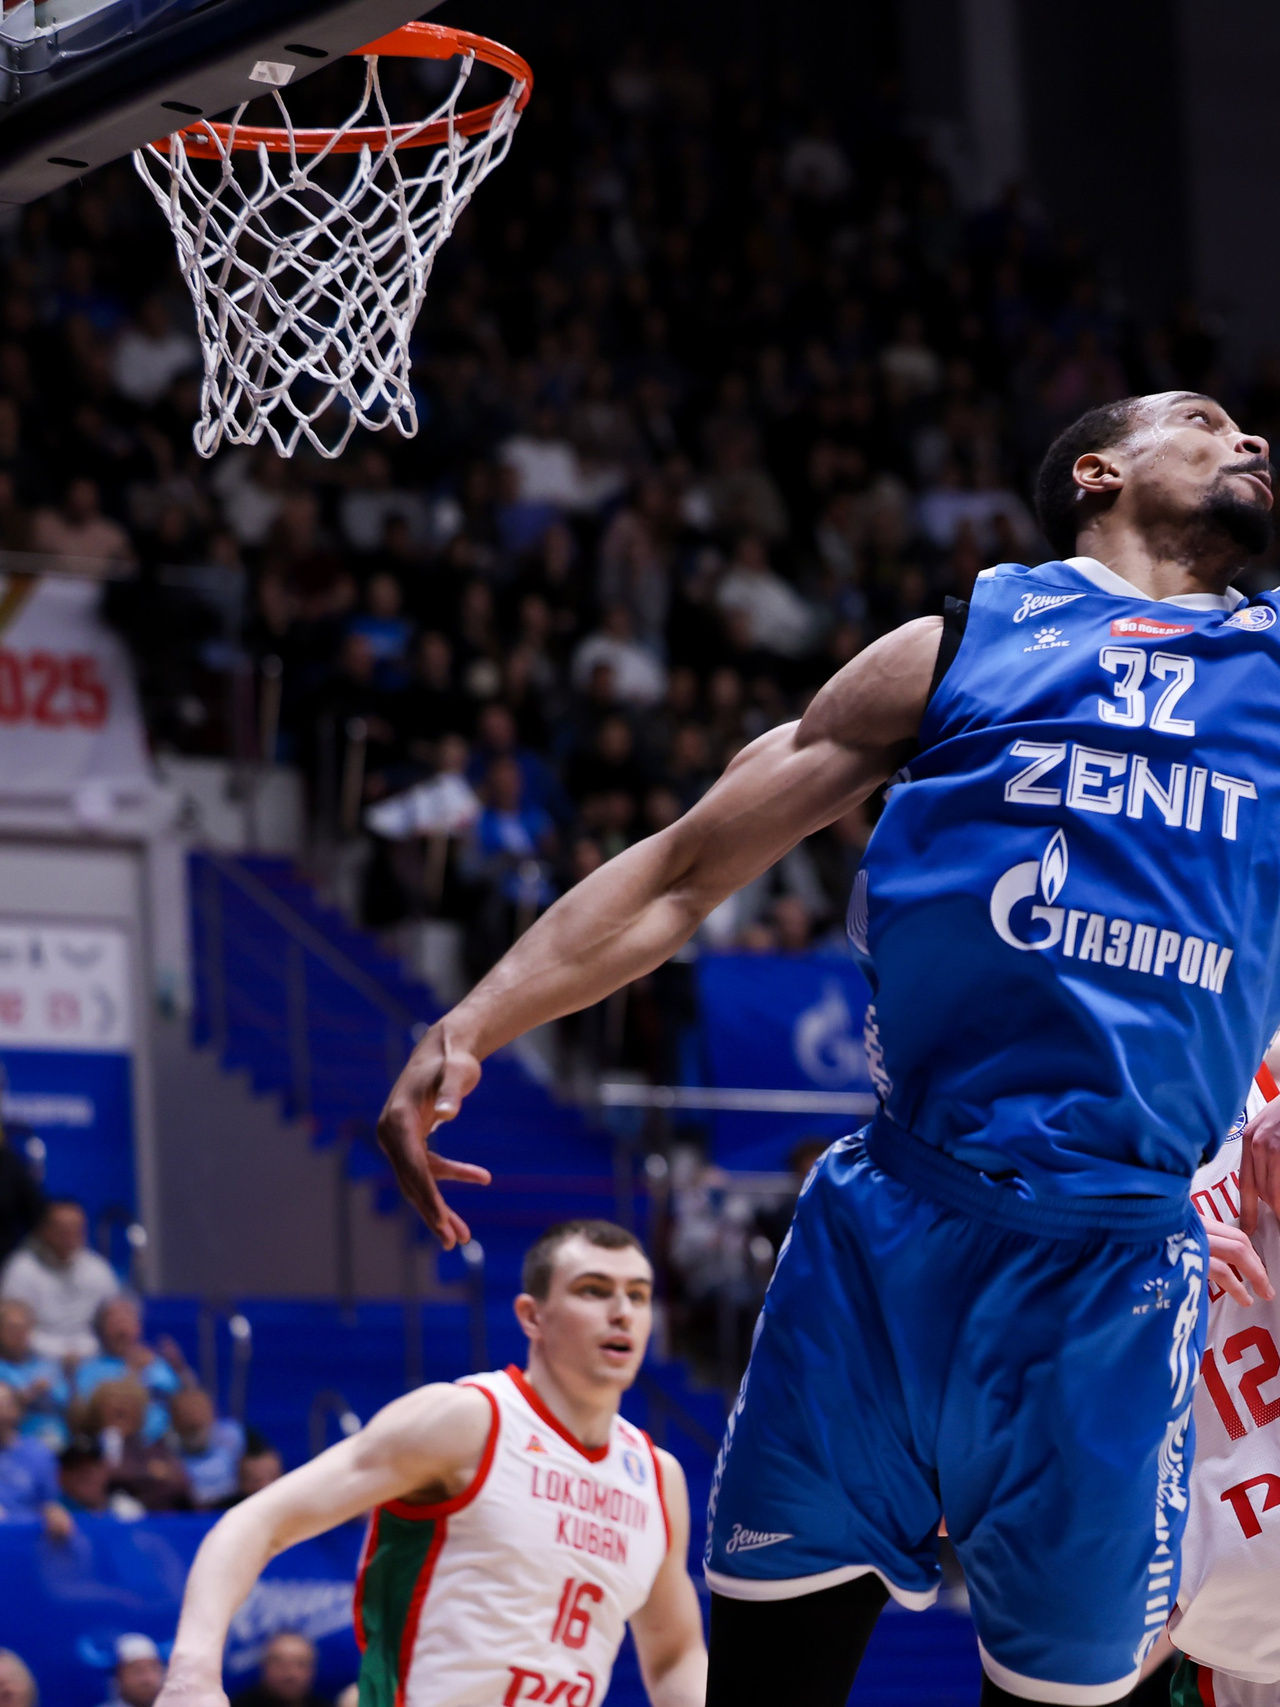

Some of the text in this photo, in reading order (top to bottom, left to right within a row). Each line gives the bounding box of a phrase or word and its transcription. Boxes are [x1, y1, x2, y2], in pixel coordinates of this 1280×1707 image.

[1013, 593, 1087, 623] Зенит
[1023, 639, 1070, 653] KELME
[1098, 646, 1195, 737] 32
[1003, 739, 1258, 841] ZENIT
[1062, 907, 1234, 995] ГАЗПРОМ
[555, 1511, 629, 1565] KUBAN
[726, 1523, 794, 1554] Зенит
[551, 1577, 604, 1650] 16
